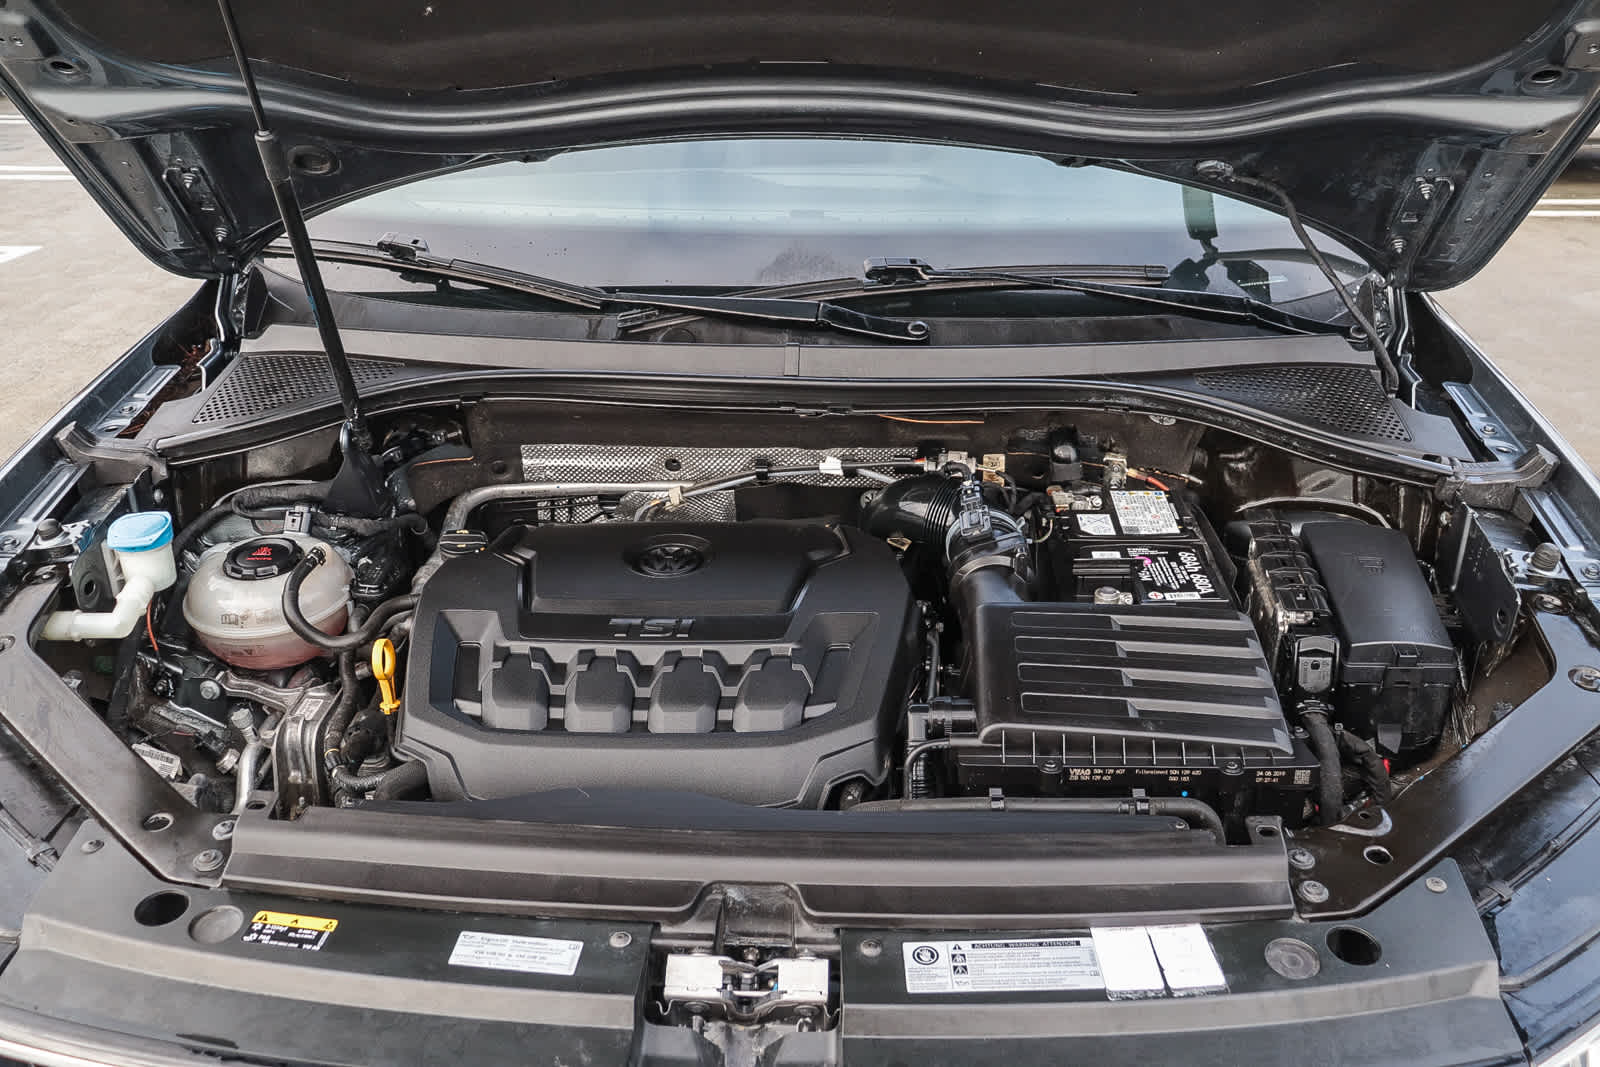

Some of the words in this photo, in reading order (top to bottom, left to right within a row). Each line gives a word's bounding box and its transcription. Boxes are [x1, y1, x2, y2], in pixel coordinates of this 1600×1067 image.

[1178, 551, 1202, 573] 68Ah
[1190, 573, 1215, 595] 680A
[609, 618, 696, 638] TSI
